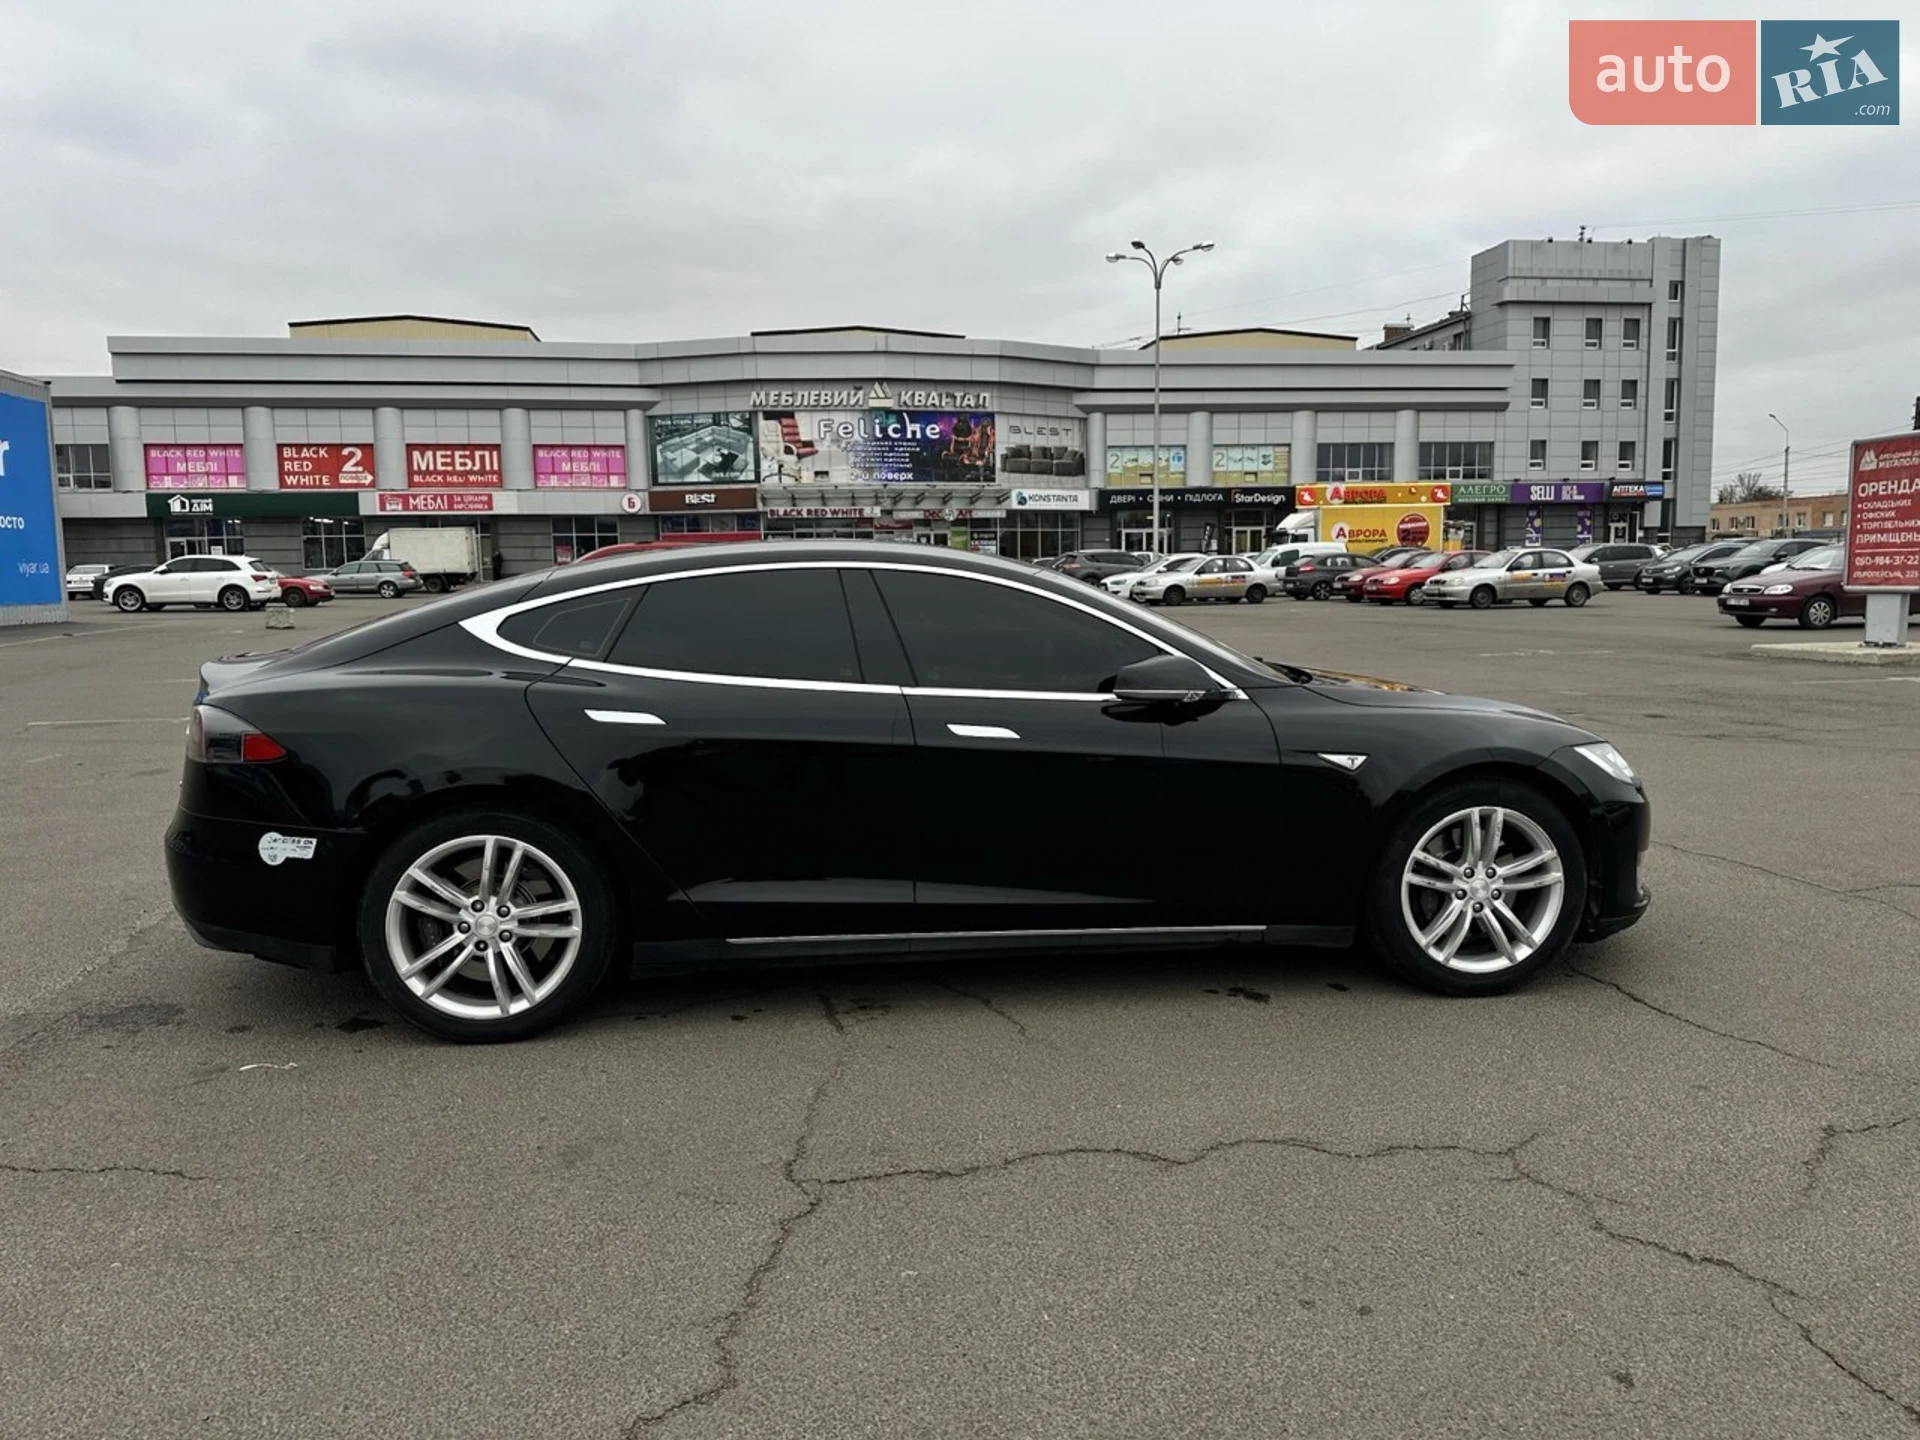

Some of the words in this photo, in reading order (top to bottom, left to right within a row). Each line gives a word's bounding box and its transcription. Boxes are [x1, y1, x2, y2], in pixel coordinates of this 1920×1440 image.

[750, 386, 865, 409] МЕБЛЕВИЙ
[899, 390, 991, 409] КВАРТАЛ
[818, 411, 941, 440] Feliche
[1009, 425, 1073, 436] BLEST
[150, 449, 182, 458] BLACK
[186, 449, 205, 458] RED
[209, 449, 241, 458] WHITE
[283, 446, 329, 459] BLACK
[537, 449, 568, 458] BLACK
[571, 449, 589, 458] RED
[591, 449, 621, 458] WHITE
[341, 446, 364, 472] 2
[411, 450, 499, 471] МЕБЛІ
[1109, 453, 1121, 469] 2
[1214, 452, 1226, 468] 2
[176, 461, 218, 473] МЕБЛІ
[284, 461, 313, 473] RED
[561, 461, 602, 473] МЕБЛІ
[285, 475, 331, 486] WHITE
[413, 474, 443, 483] BLACK
[467, 474, 499, 483] WHITE
[1458, 485, 1506, 495] АЛЕГРО
[1530, 485, 1555, 501] SELLI
[1611, 485, 1645, 493] АПТЕКА
[1858, 477, 1920, 497] ОРЕНДА
[408, 494, 448, 510] МЕБЛІ
[1028, 493, 1079, 503] KONSTANTA
[1109, 494, 1136, 504] ДВЕРІ
[1146, 494, 1174, 503] СНИ
[1184, 493, 1224, 503] ПІДЛОГА
[1235, 493, 1286, 505] StarDesign
[769, 508, 804, 517] BLACK
[807, 508, 828, 517] RED
[829, 507, 865, 517] WHITE
[1855, 531, 1920, 544] ПРИМІЩЕНЬ
[18, 559, 50, 577] viyar.ua
